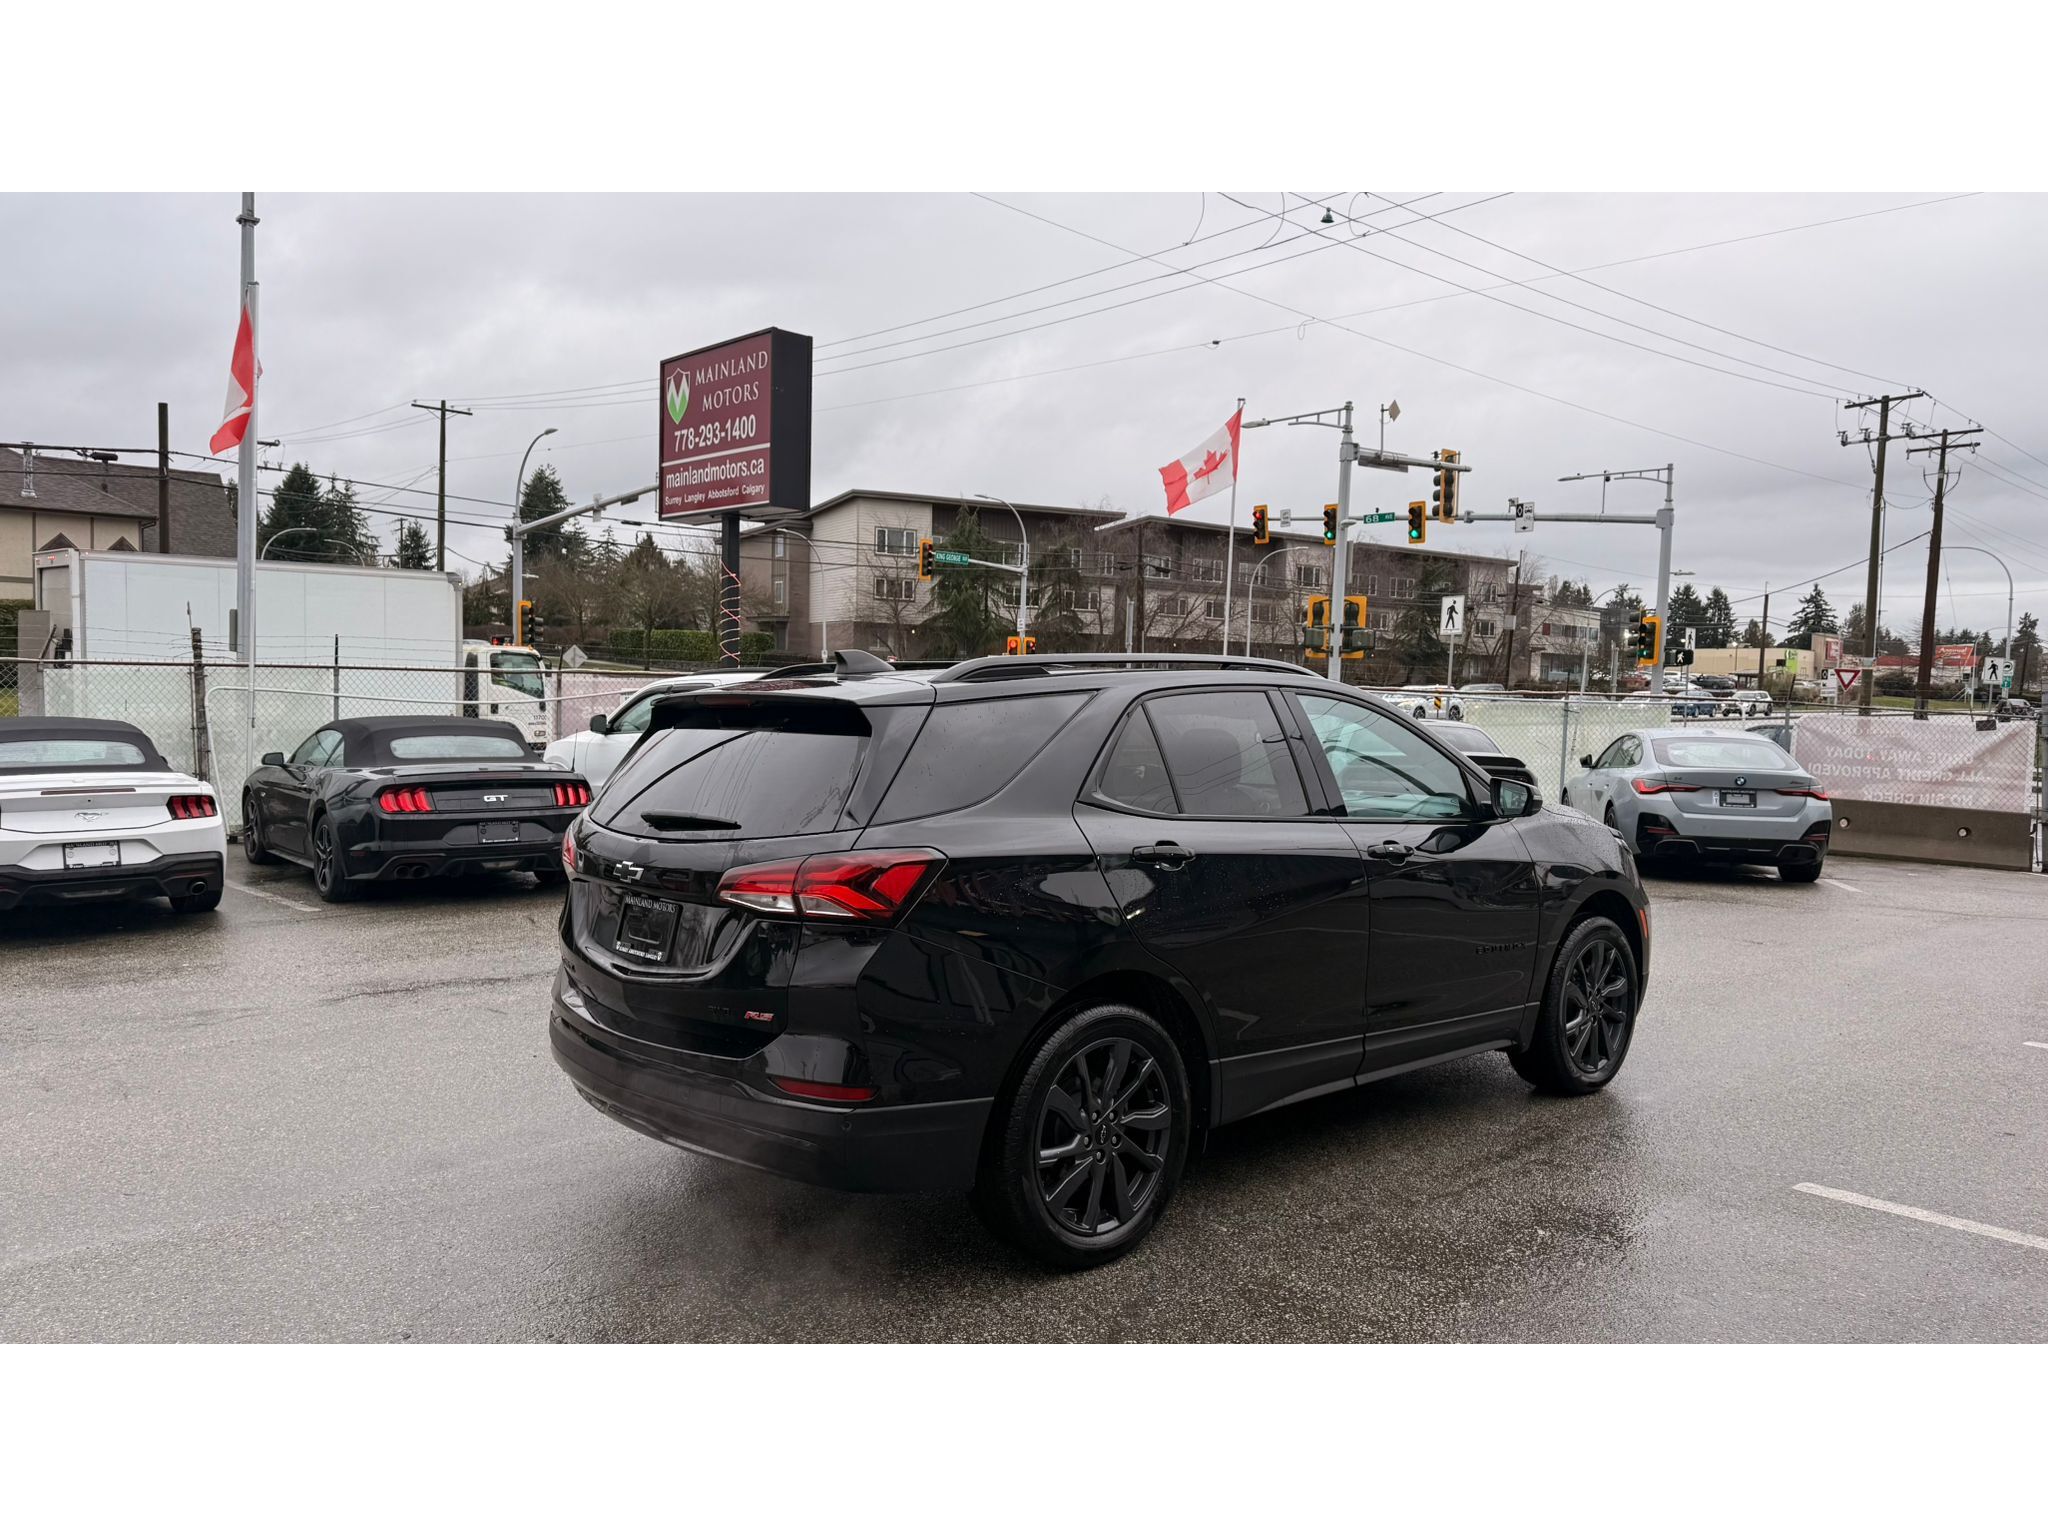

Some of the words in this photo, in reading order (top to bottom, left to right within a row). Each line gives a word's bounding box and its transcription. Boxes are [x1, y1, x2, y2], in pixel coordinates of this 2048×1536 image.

[695, 351, 768, 386] MAINLAND
[702, 381, 759, 412] MOTORS
[674, 414, 756, 452] 778-293-1400
[666, 458, 764, 488] mainlandmotors.ca
[665, 496, 682, 505] Surrey
[684, 492, 705, 504] Langley
[707, 486, 739, 499] Abbotsford
[741, 484, 765, 496] Calgary
[1365, 514, 1379, 523] 68
[625, 896, 652, 908] MAINLAND
[653, 901, 677, 913] MOTORS
[744, 1010, 774, 1021] RS
